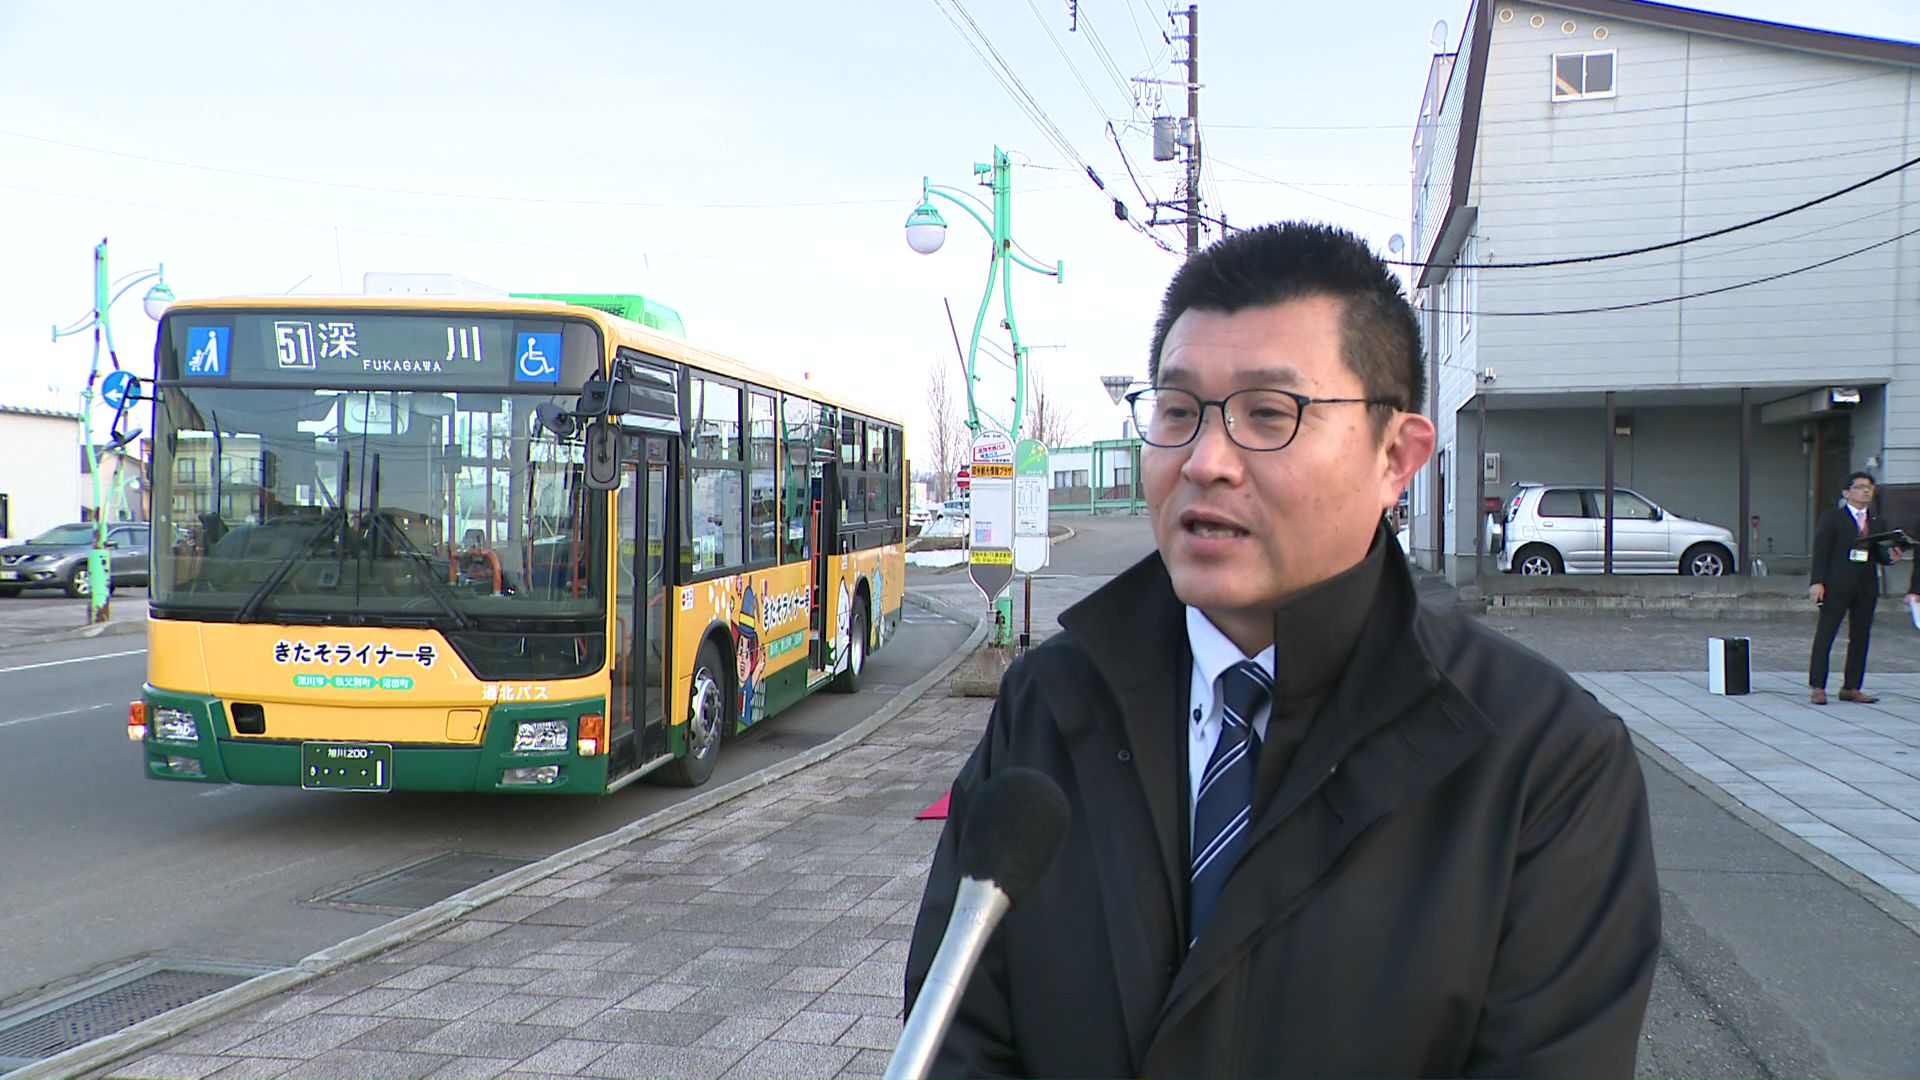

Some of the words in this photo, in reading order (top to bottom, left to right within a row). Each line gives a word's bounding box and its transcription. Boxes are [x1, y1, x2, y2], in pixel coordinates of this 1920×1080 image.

[279, 327, 311, 365] 51
[363, 359, 442, 373] FUKAGAWA
[763, 585, 811, 632] きたそライナー号
[274, 641, 436, 668] きたそライナー号
[482, 684, 548, 701] 道北バス
